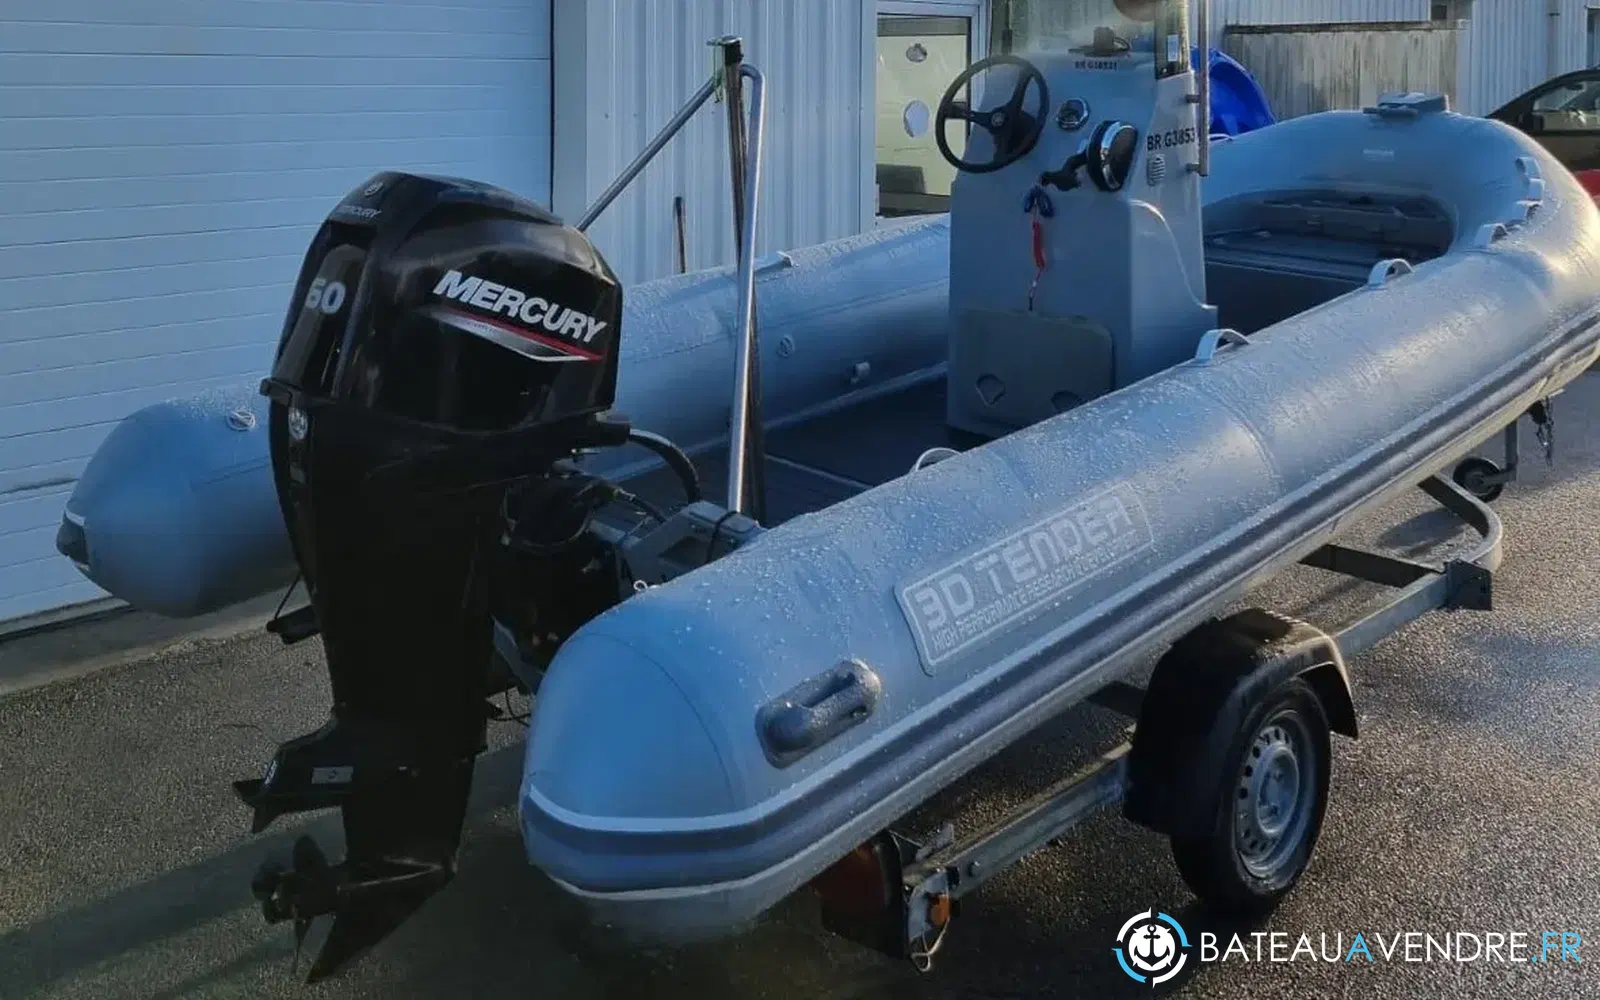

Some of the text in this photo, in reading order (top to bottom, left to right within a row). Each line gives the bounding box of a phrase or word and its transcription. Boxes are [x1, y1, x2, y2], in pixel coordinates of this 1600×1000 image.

[1147, 126, 1199, 151] BR G3853
[305, 277, 346, 314] 60
[432, 269, 607, 343] MERCURY
[914, 497, 1134, 631] 3D TENDER
